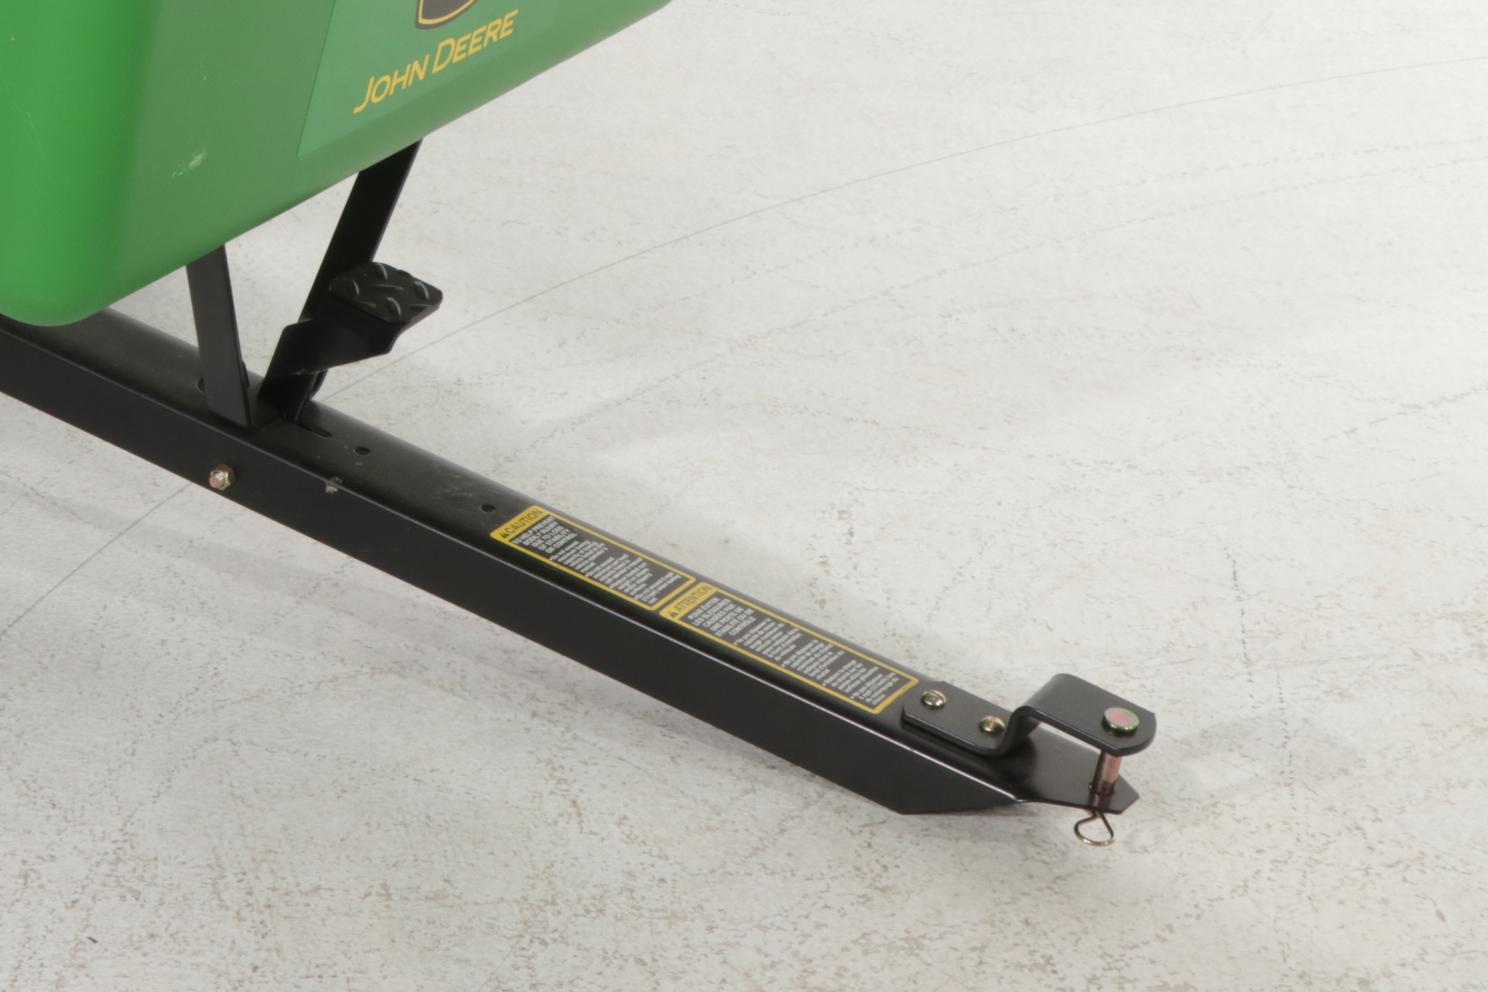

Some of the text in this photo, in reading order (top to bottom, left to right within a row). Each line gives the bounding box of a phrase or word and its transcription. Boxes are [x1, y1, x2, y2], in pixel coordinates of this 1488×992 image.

[353, 9, 519, 114] JOHN DEERE
[505, 509, 543, 535] CAUTION
